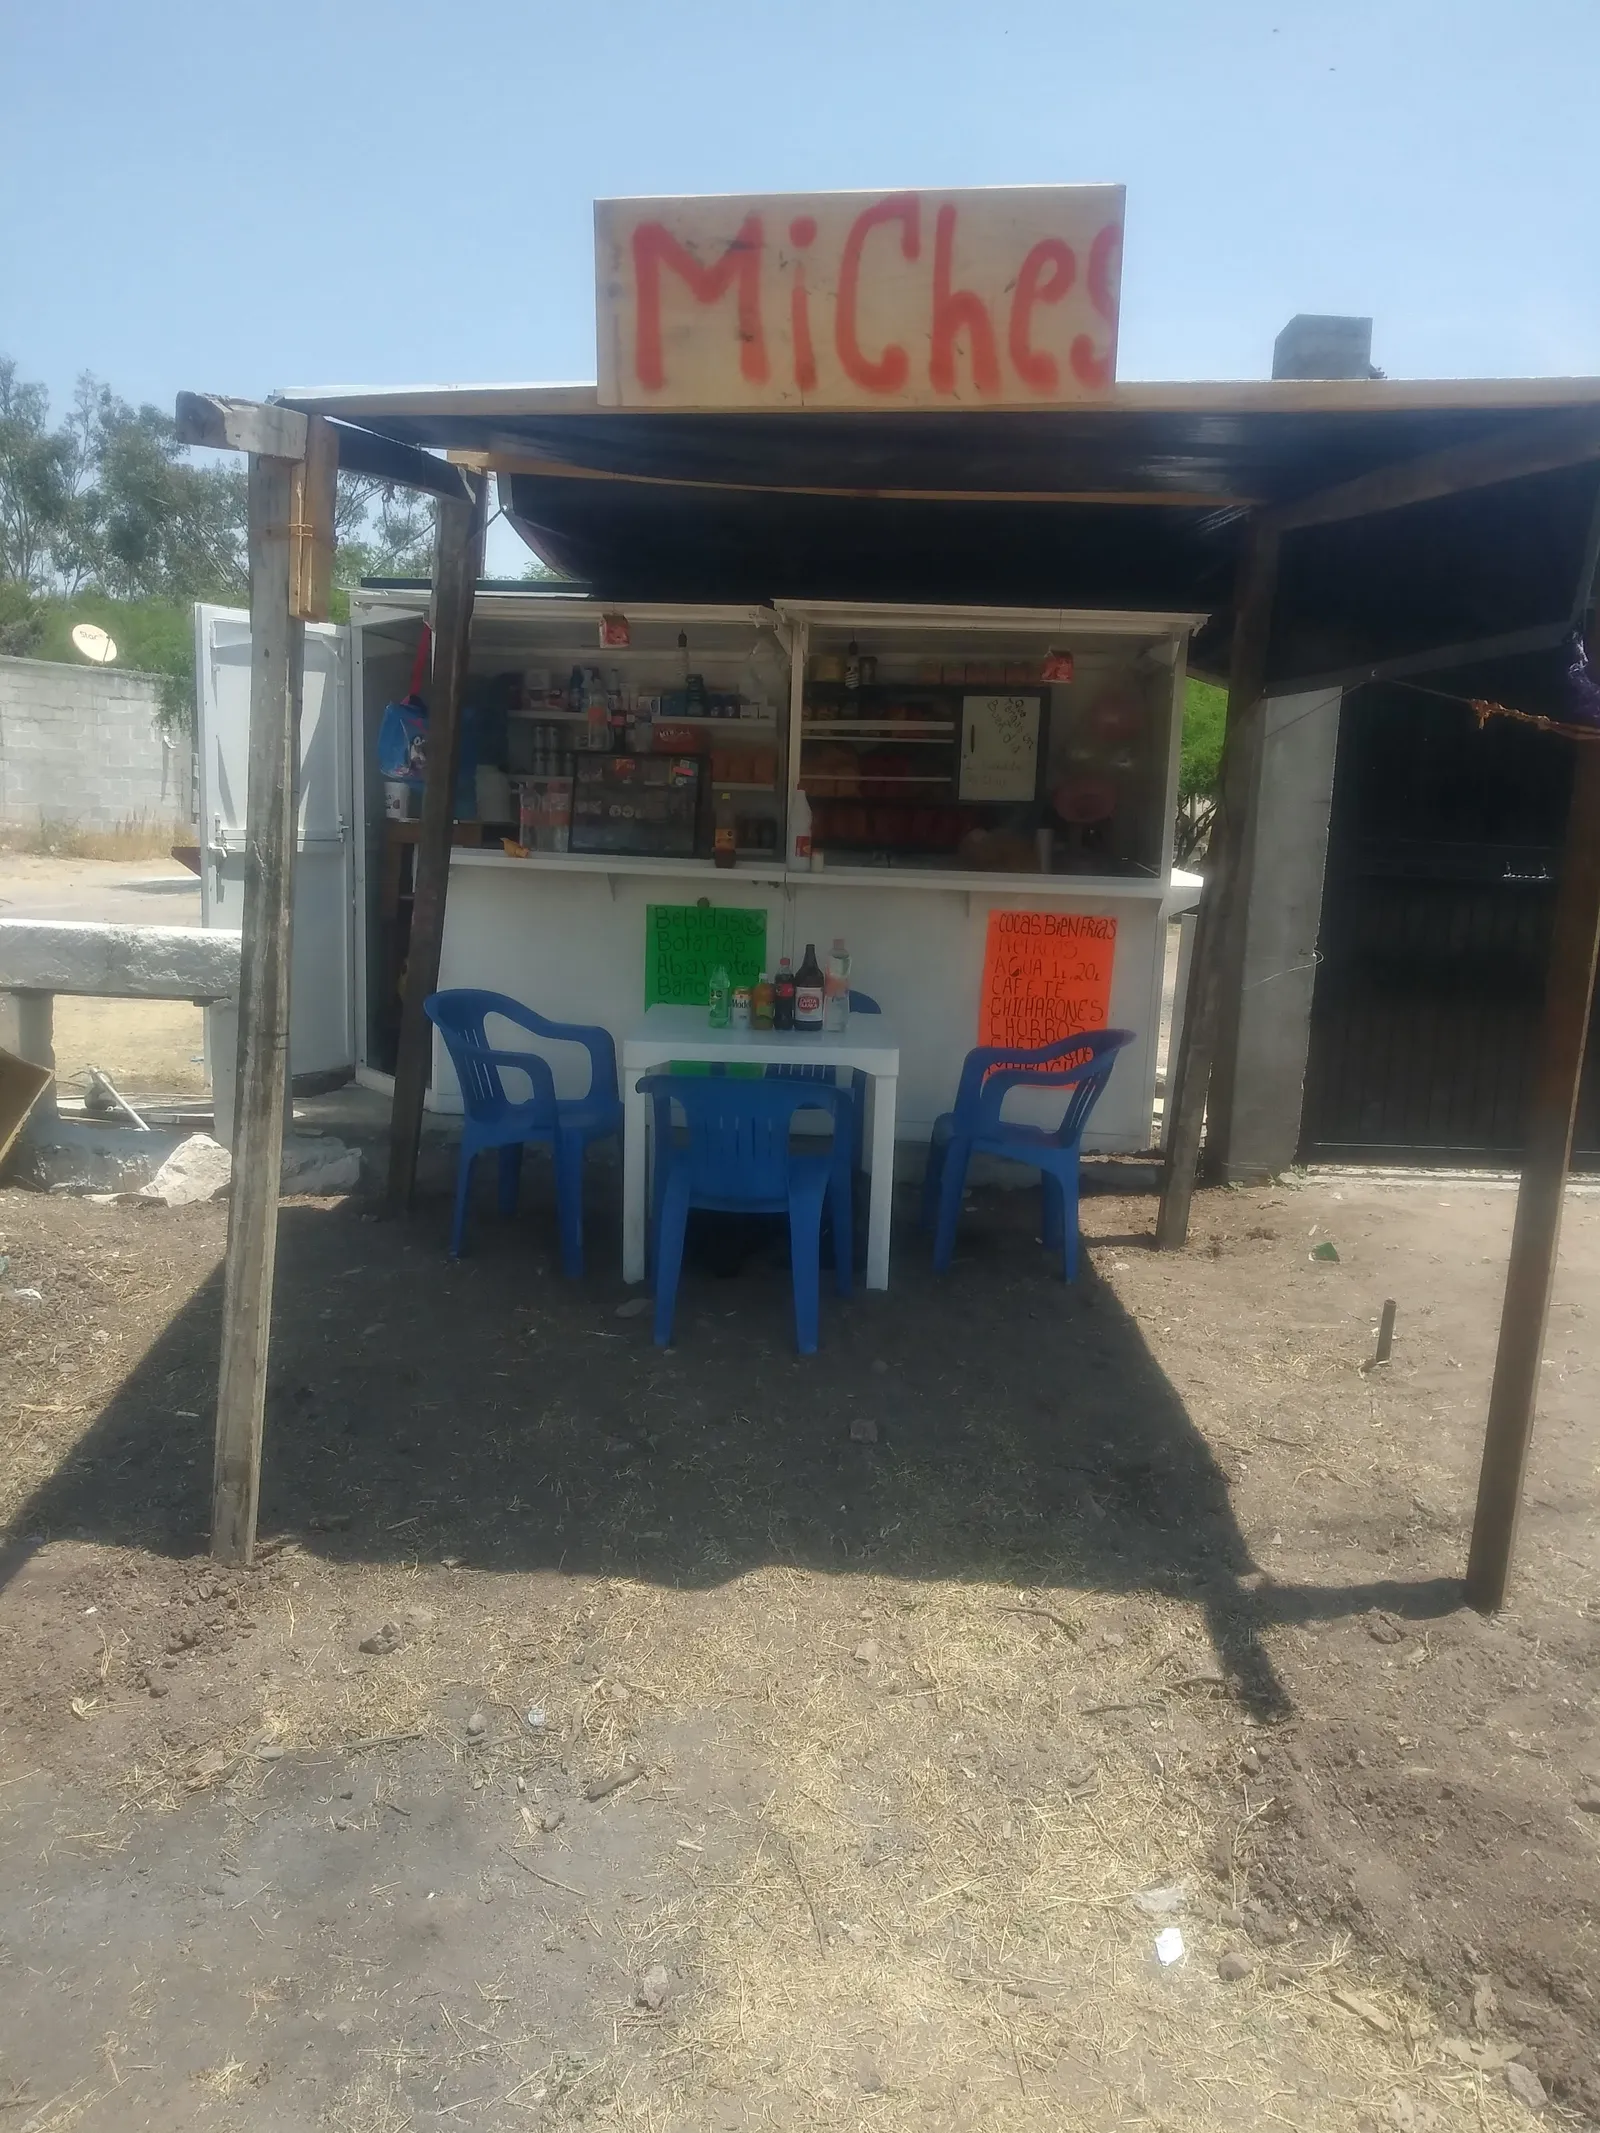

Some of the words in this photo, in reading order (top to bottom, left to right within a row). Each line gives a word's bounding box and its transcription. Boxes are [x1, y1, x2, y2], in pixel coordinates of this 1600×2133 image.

[655, 907, 741, 932] Bebidas
[657, 931, 746, 953] Botanas
[657, 953, 761, 977] Abartes
[994, 956, 1042, 978] AGUA
